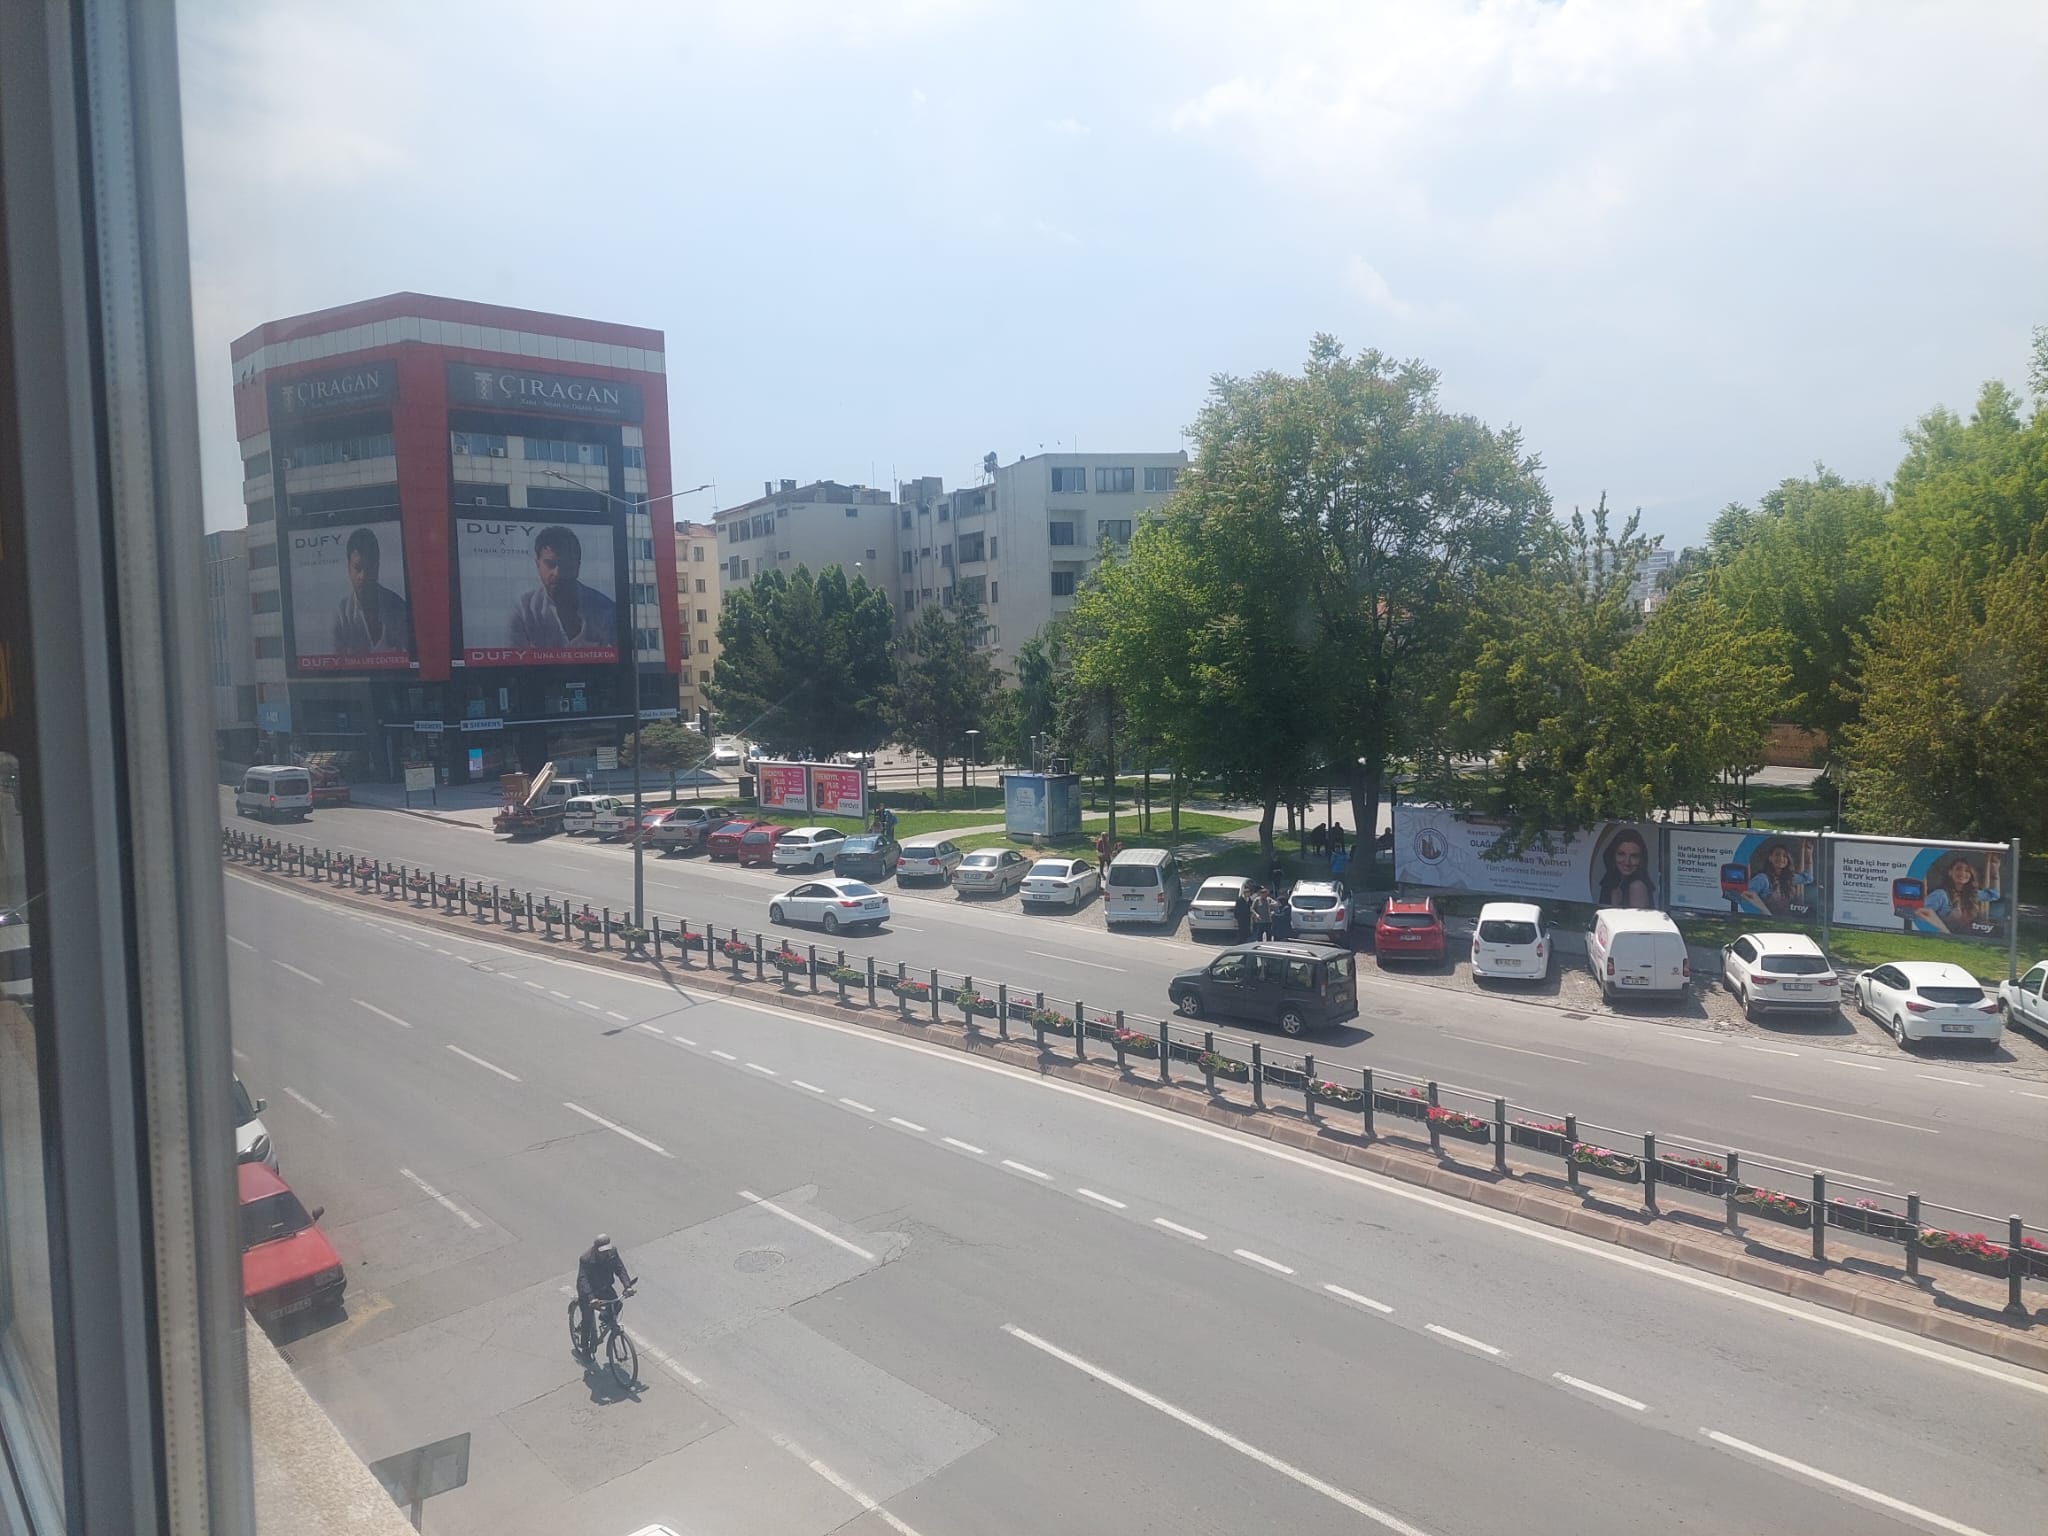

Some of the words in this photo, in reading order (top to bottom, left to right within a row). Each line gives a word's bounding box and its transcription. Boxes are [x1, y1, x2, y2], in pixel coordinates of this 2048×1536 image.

[466, 523, 535, 536] DUFY
[296, 534, 342, 549] DUFY
[471, 650, 527, 661] DUFY
[555, 651, 572, 659] LIFE
[302, 657, 341, 667] DUFY
[470, 721, 502, 729] SIEMENS
[1843, 857, 1864, 866] Hafta
[1865, 859, 1875, 867] içi
[1876, 859, 1890, 867] her
[1854, 866, 1887, 874] ulaşımın
[1843, 872, 1864, 880] TROY
[1866, 874, 1889, 882] kartla
[1790, 903, 1808, 914] troy
[1972, 921, 1994, 934] troy
